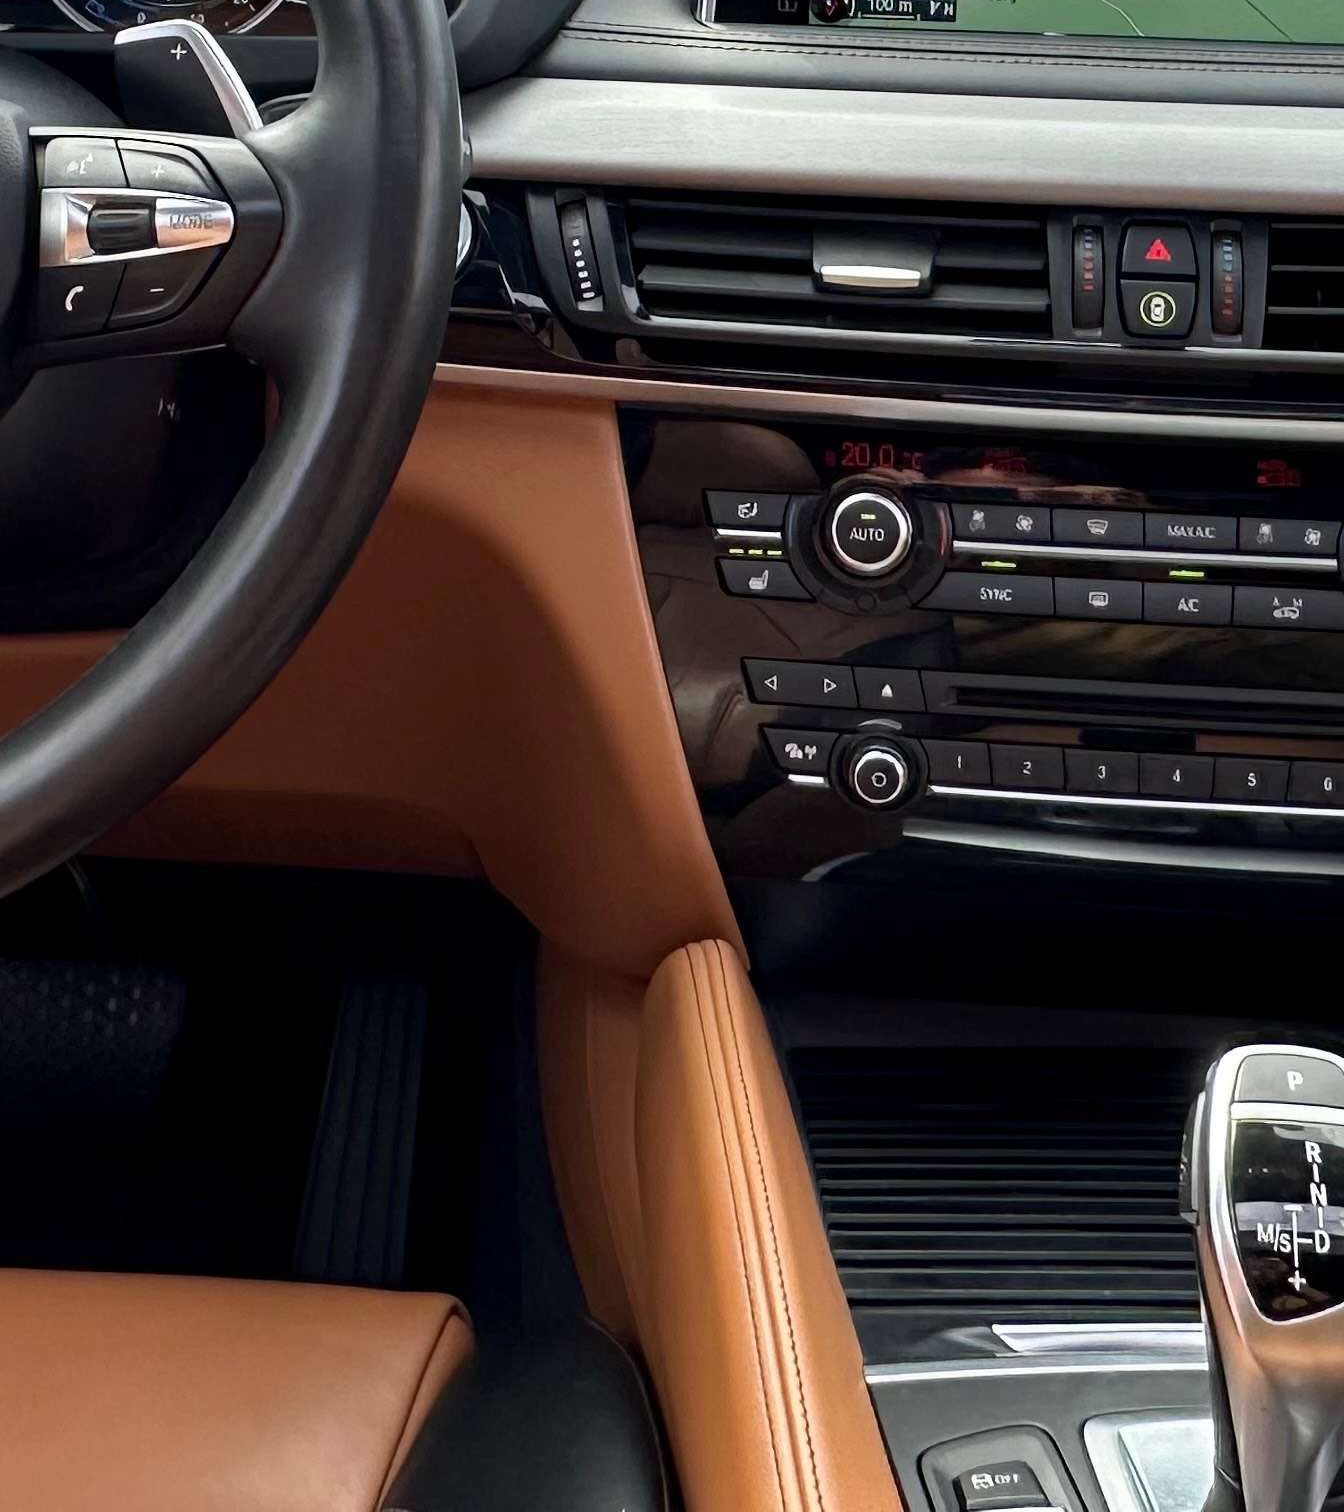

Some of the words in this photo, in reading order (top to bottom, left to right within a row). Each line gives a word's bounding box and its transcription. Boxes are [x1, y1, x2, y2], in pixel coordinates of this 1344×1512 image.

[898, 0, 913, 14] m
[840, 442, 895, 469] 20.0
[848, 526, 886, 544] AUTO
[1022, 760, 1033, 776] 2
[1097, 764, 1107, 780] 3
[1287, 1070, 1304, 1091] P
[1305, 1140, 1323, 1164] R
[1309, 1182, 1328, 1208] N
[1314, 1229, 1331, 1254] D
